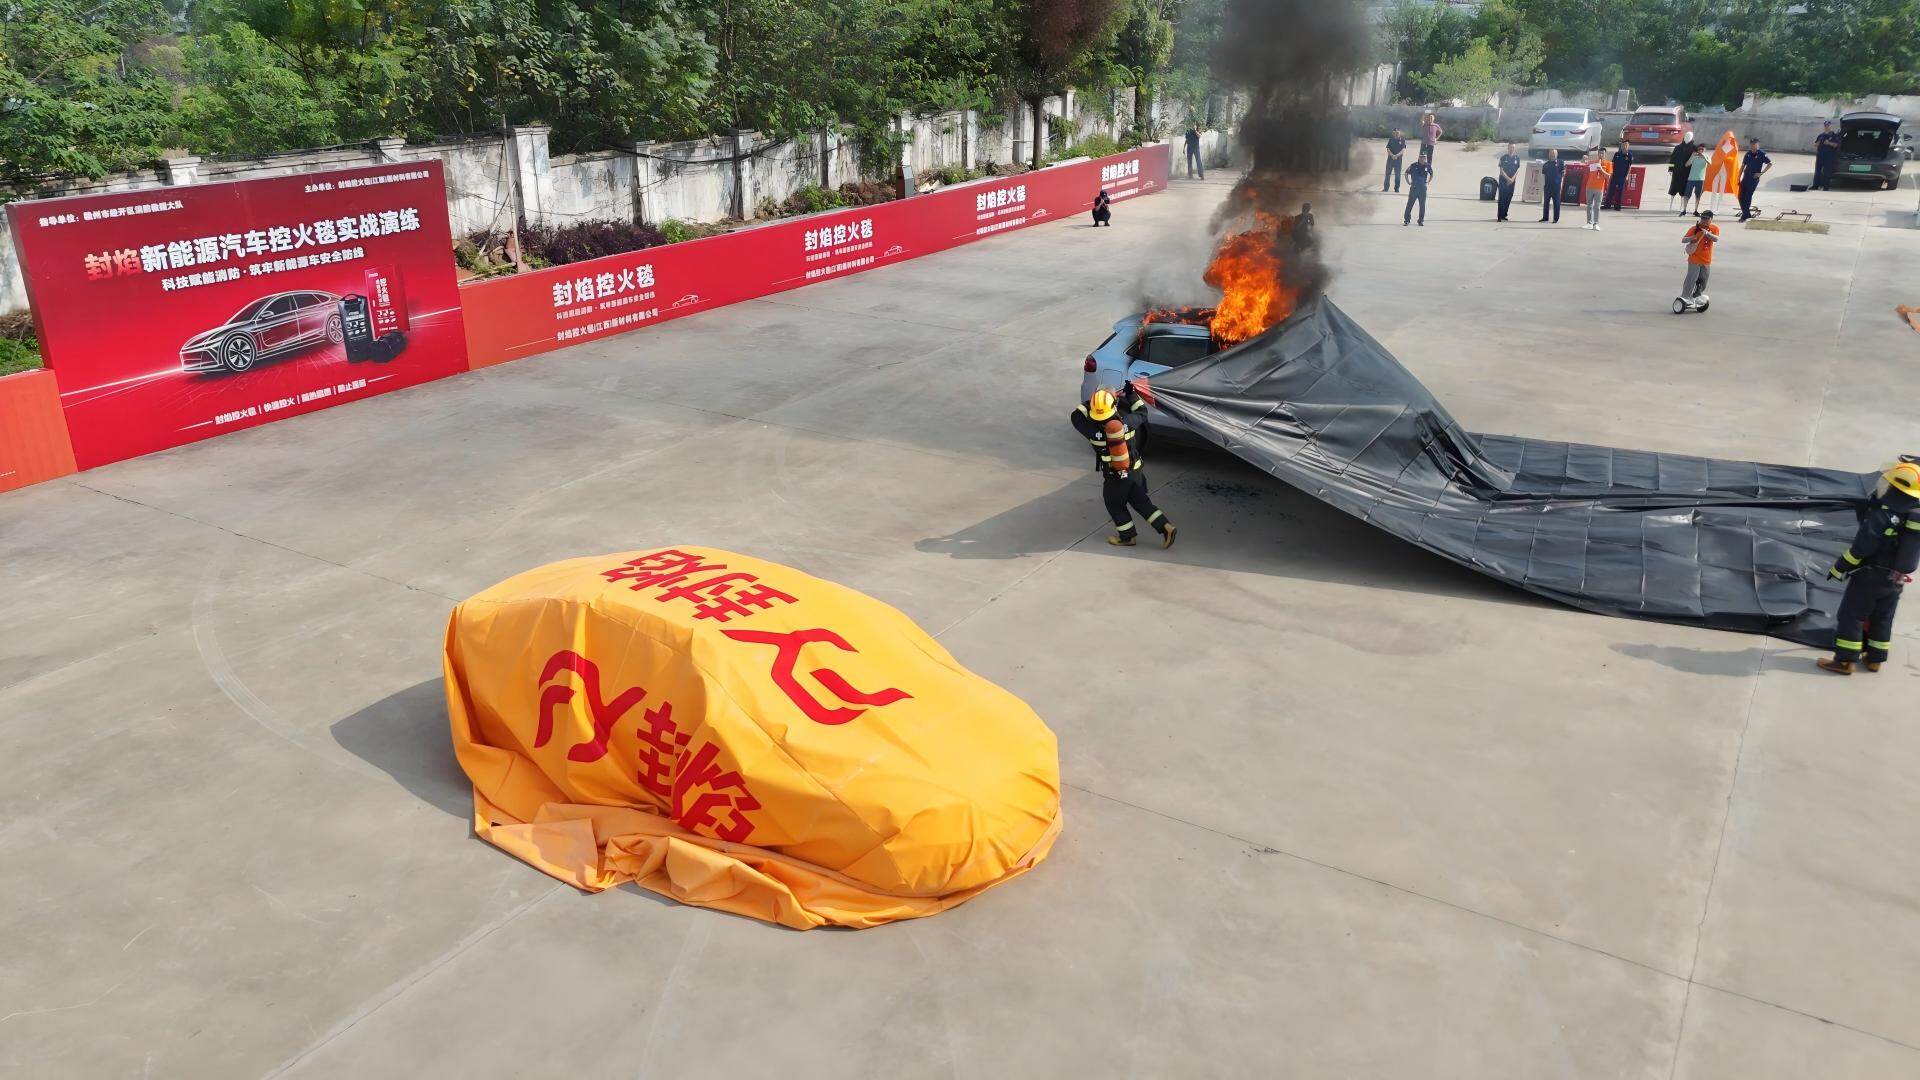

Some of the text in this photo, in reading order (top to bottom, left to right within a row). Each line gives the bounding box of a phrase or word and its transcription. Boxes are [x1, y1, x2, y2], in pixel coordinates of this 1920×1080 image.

[977, 185, 1025, 211] 封焰控火毯
[805, 218, 873, 251] 封焰控火毯
[552, 264, 655, 307] 封焰控火毯
[600, 549, 799, 622] 封焰
[636, 700, 762, 843] 封焰
